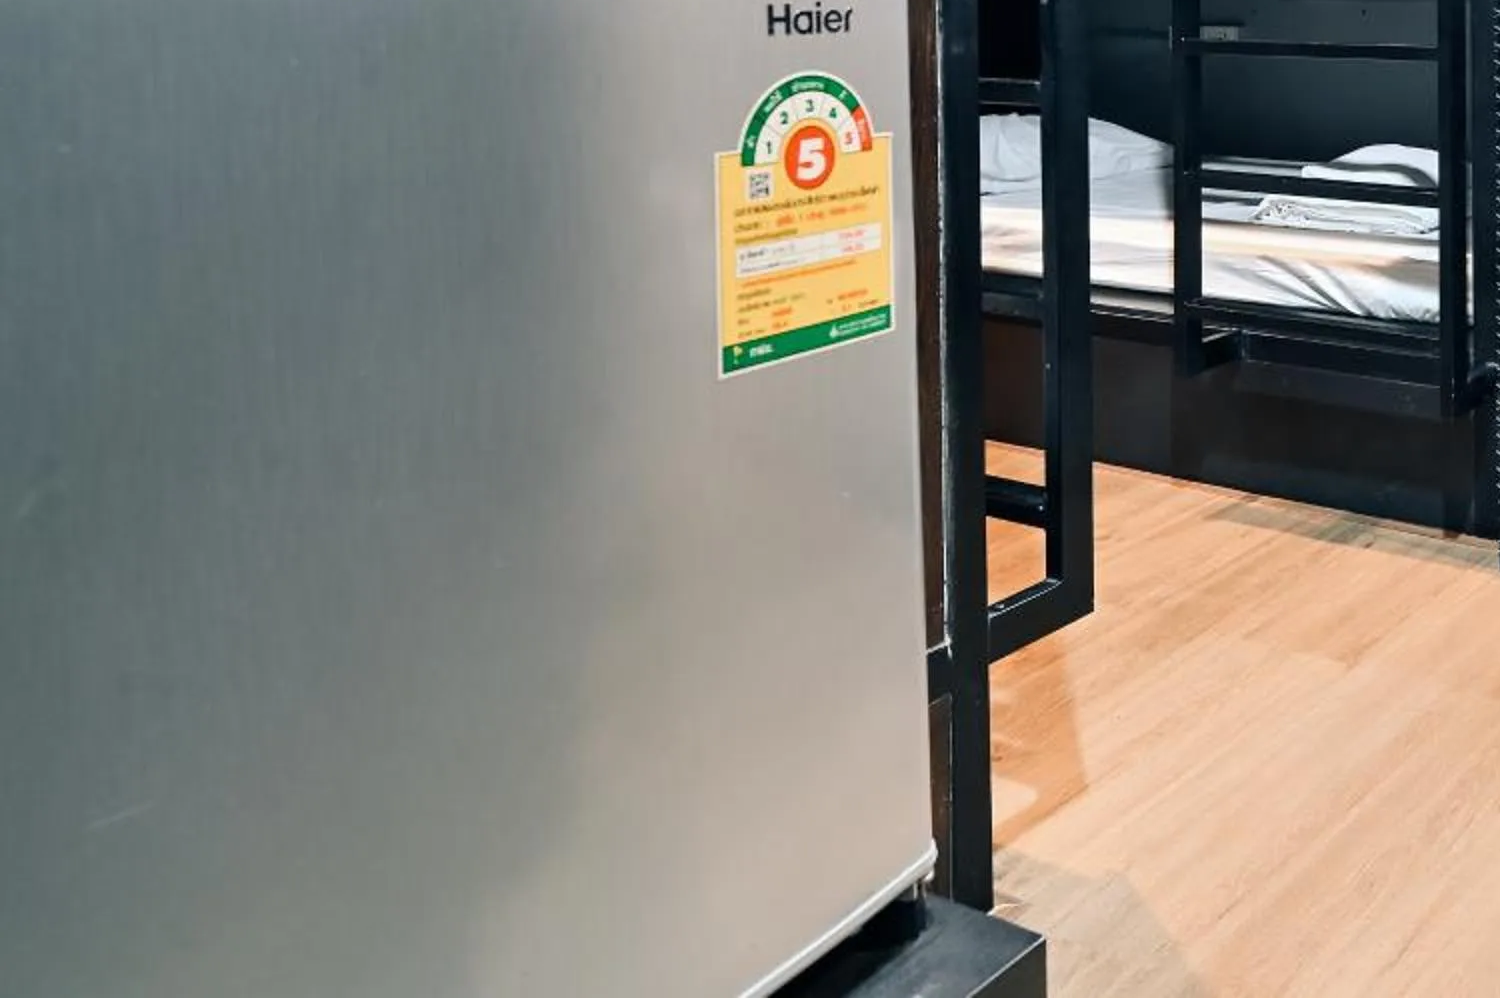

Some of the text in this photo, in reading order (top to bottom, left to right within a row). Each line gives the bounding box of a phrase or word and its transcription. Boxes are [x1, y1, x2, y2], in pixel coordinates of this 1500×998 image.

[767, 1, 853, 36] Haier
[779, 110, 789, 125] 2
[804, 98, 815, 113] 3
[828, 106, 838, 120] 4
[795, 136, 828, 181] 5
